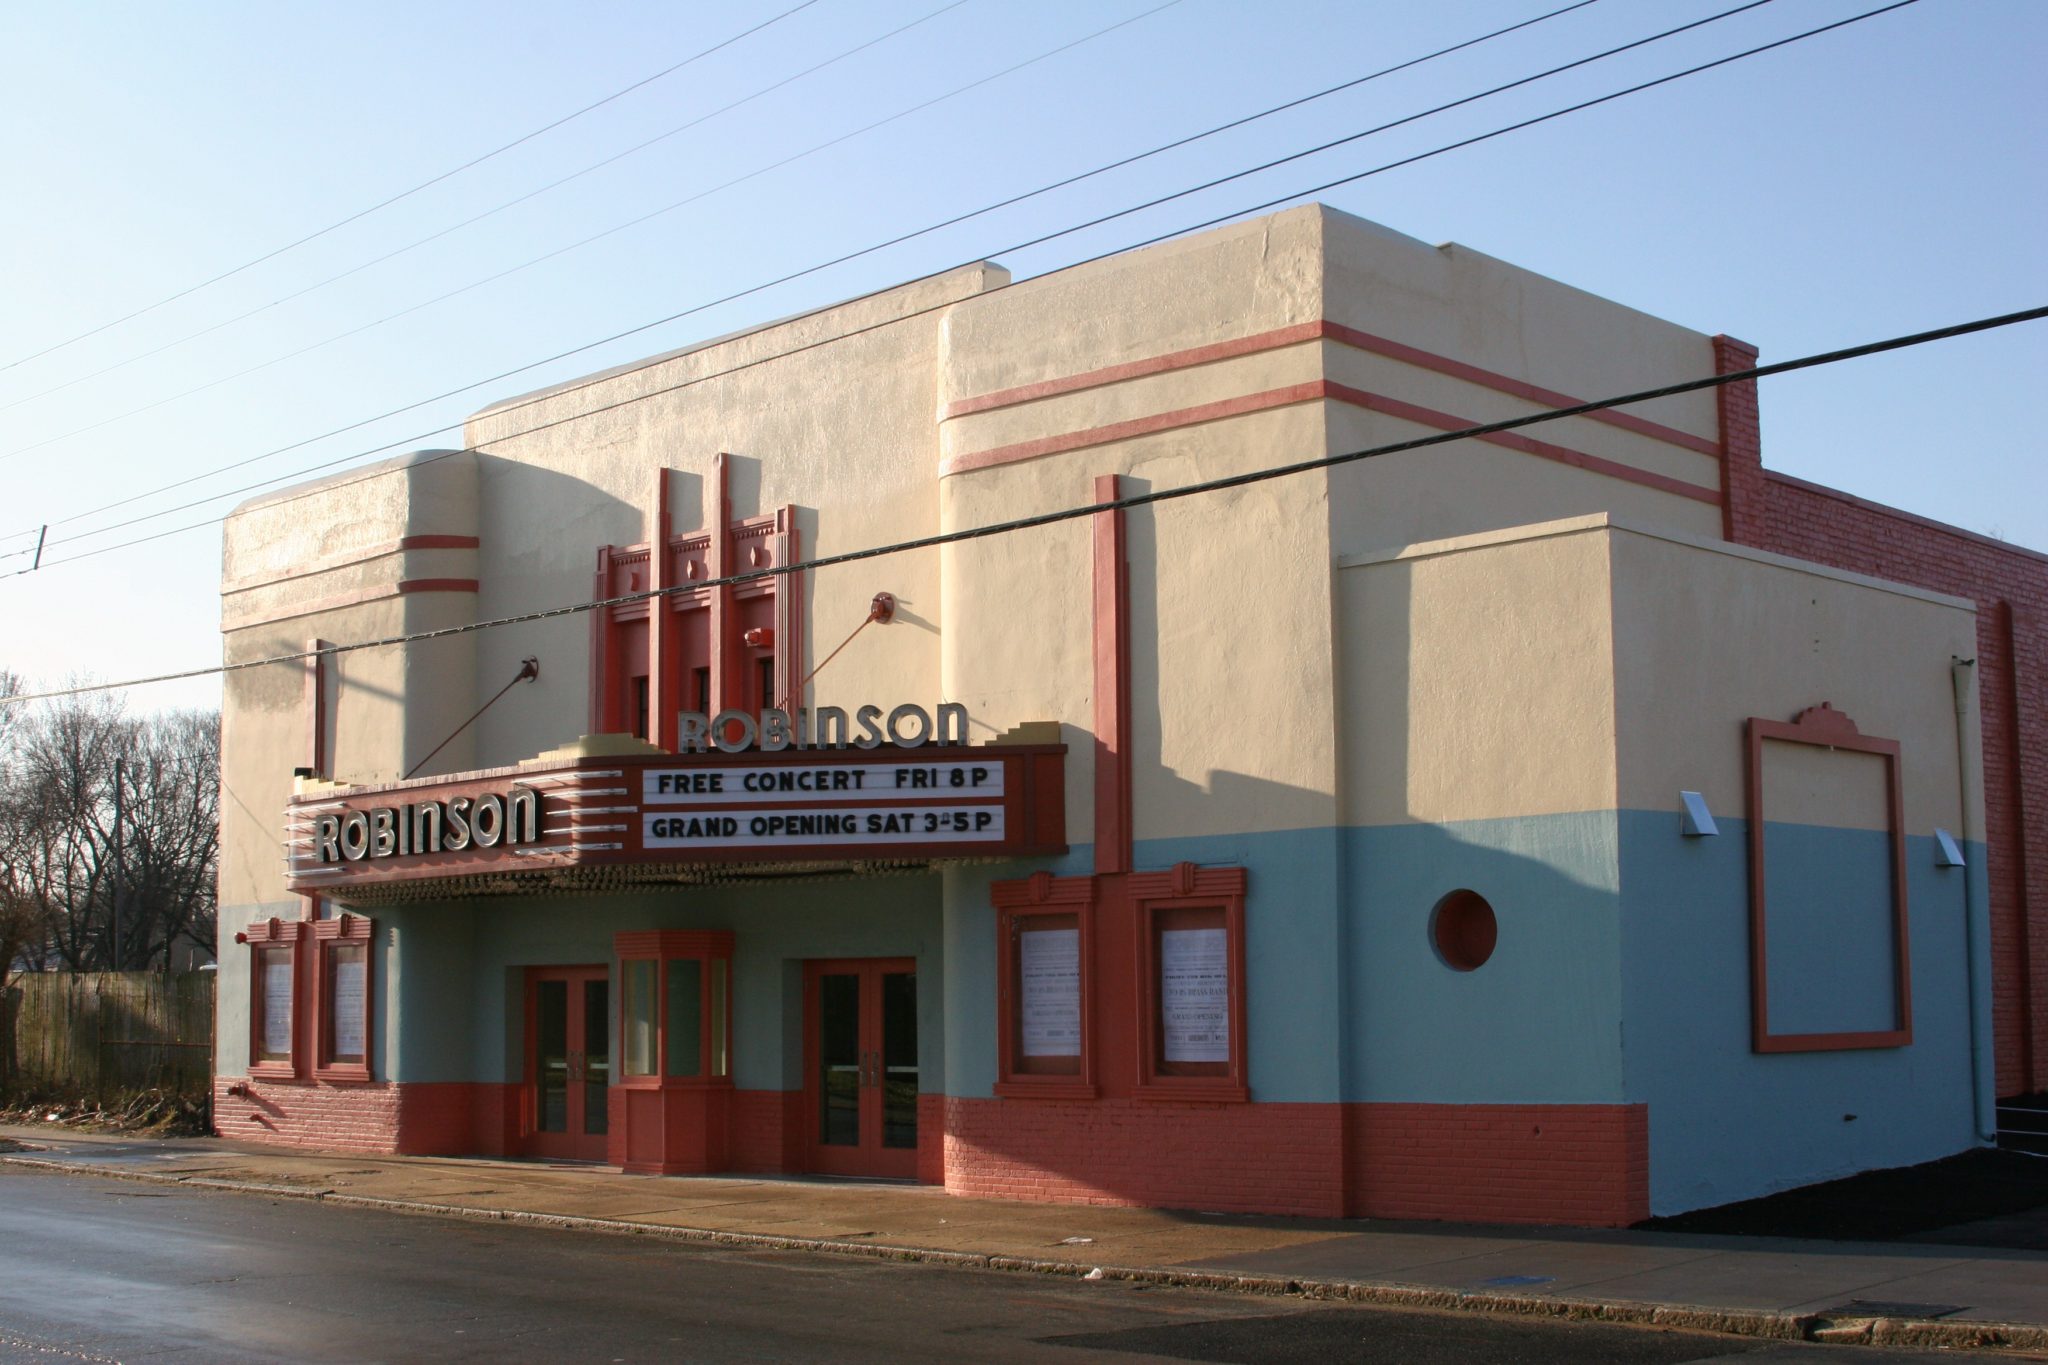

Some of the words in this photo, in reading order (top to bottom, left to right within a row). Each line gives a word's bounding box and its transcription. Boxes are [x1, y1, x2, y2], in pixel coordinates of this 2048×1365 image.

[658, 773, 723, 794] FREE
[743, 770, 866, 792] CONCERT
[895, 768, 937, 789] FRI
[652, 817, 738, 838] GRAND
[750, 814, 857, 836] OPENING
[867, 813, 915, 834] SAT
